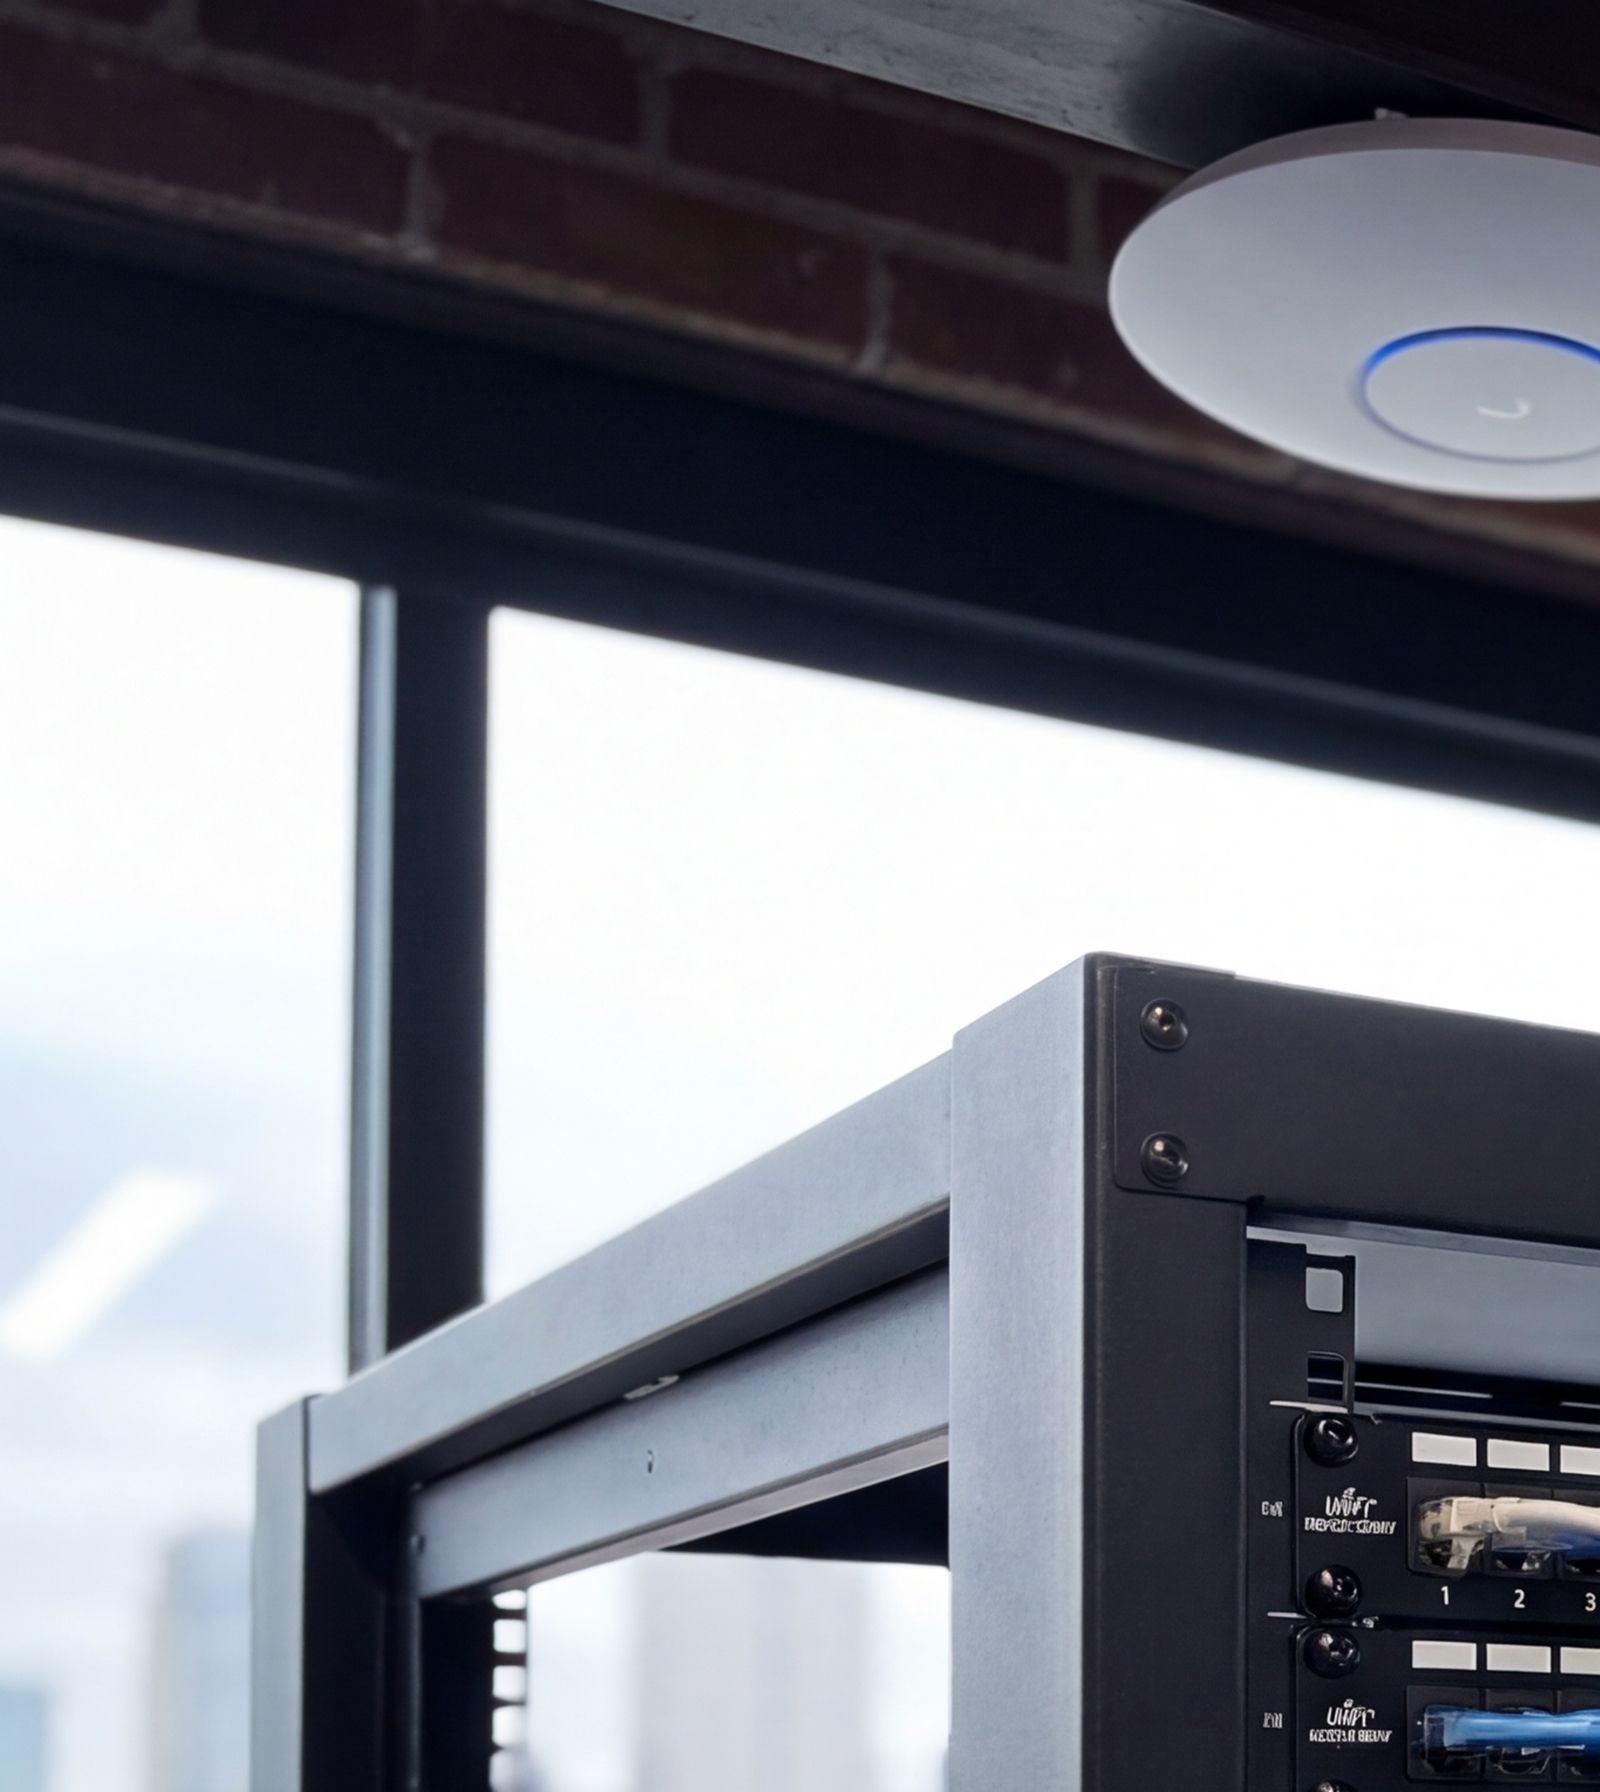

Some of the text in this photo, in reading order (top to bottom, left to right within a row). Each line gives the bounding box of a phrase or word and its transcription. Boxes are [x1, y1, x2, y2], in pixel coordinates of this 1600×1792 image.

[1440, 1585, 1449, 1605] 1
[1514, 1588, 1526, 1609] 2
[1585, 1592, 1597, 1612] 3
